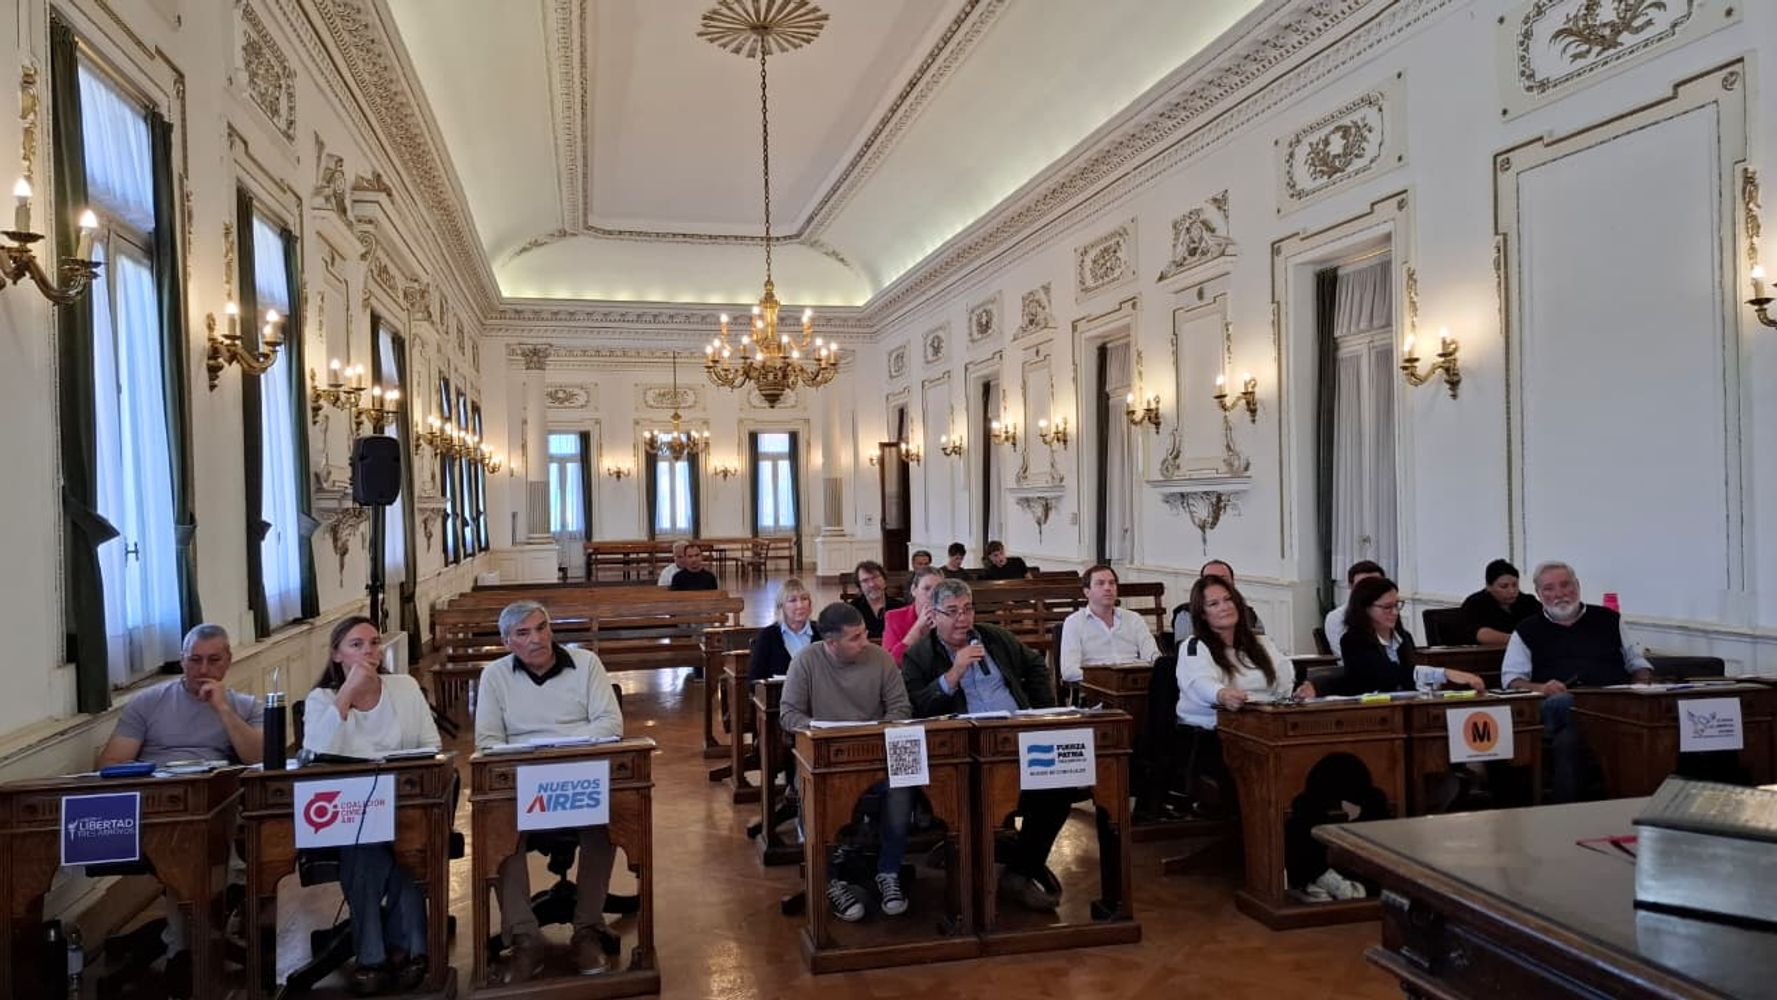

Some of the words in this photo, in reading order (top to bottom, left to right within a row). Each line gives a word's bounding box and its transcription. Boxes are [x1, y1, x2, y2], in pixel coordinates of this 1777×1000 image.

[1472, 720, 1491, 743] M
[1056, 743, 1086, 751] FUERZA
[1057, 751, 1084, 760] PATRIA
[537, 778, 601, 793] NUEVOS
[526, 790, 602, 814] AIRES
[79, 817, 134, 831] LIBERTAD
